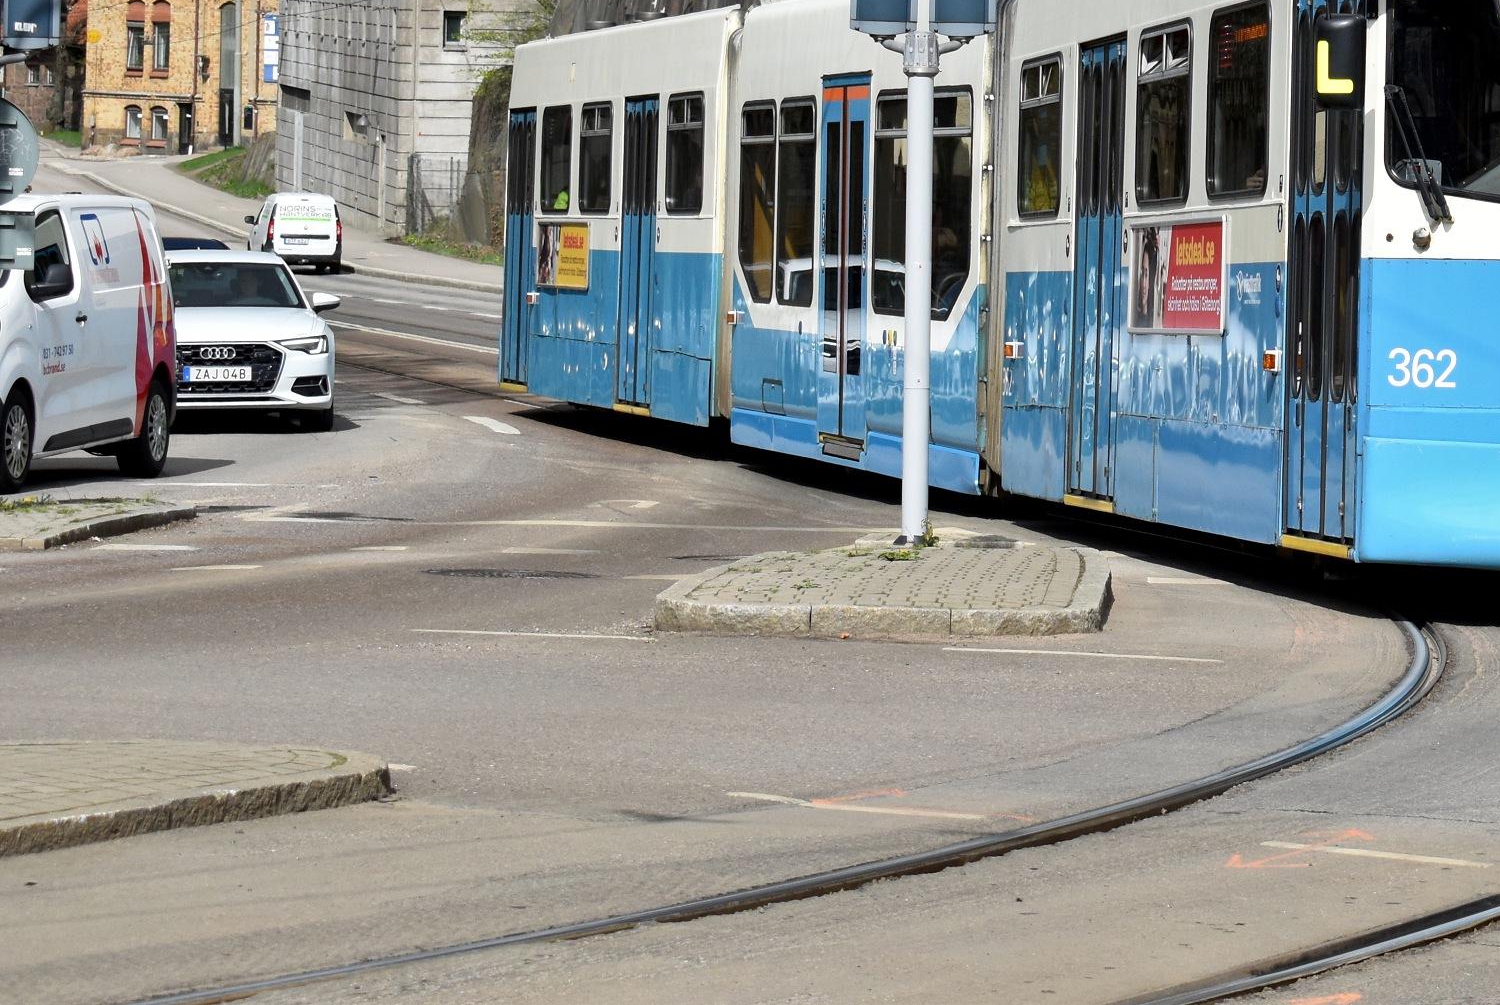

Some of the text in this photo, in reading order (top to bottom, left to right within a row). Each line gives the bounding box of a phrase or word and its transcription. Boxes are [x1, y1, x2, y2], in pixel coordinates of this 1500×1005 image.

[1176, 236, 1215, 265] letsdeal.se
[195, 368, 219, 380] ZAJ
[1387, 347, 1457, 388] 362
